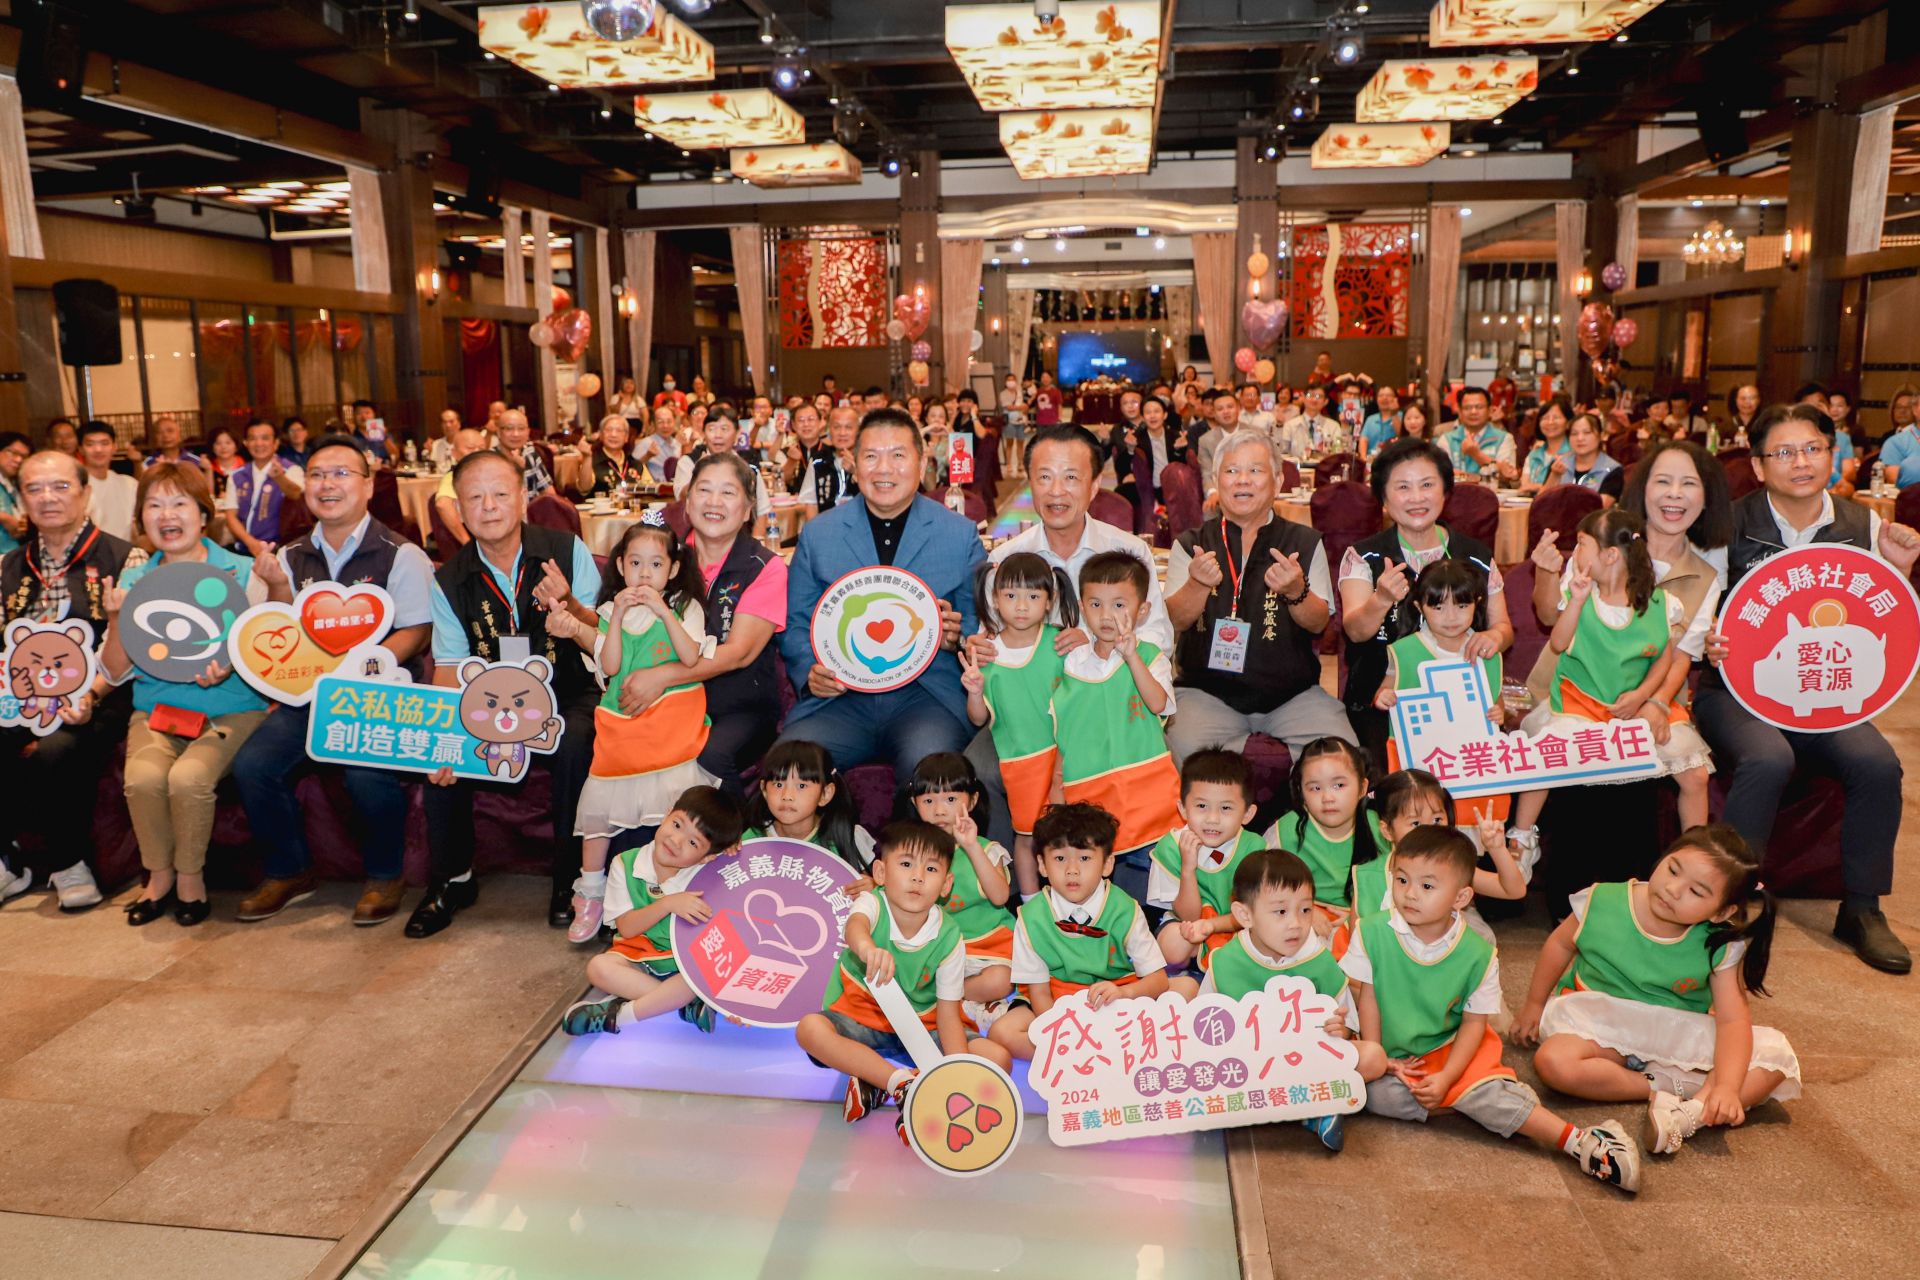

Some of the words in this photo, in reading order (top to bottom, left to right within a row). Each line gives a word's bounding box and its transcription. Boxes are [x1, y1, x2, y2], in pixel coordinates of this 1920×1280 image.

[952, 457, 970, 475] 主桌
[1737, 562, 1899, 629] 嘉義縣社會局
[1797, 640, 1852, 667] 愛心
[1797, 667, 1853, 693] 資源
[329, 687, 457, 729] 公私協力
[323, 720, 468, 766] 創造雙贏
[1422, 725, 1650, 782] 企業社會責任
[700, 925, 733, 979] 愛心
[732, 967, 796, 995] 資源
[1138, 1058, 1245, 1093] 讓愛發光
[1061, 1088, 1100, 1105] 2024
[1061, 1079, 1352, 1132] 嘉義地區慈善公益感恩餐敘活動
